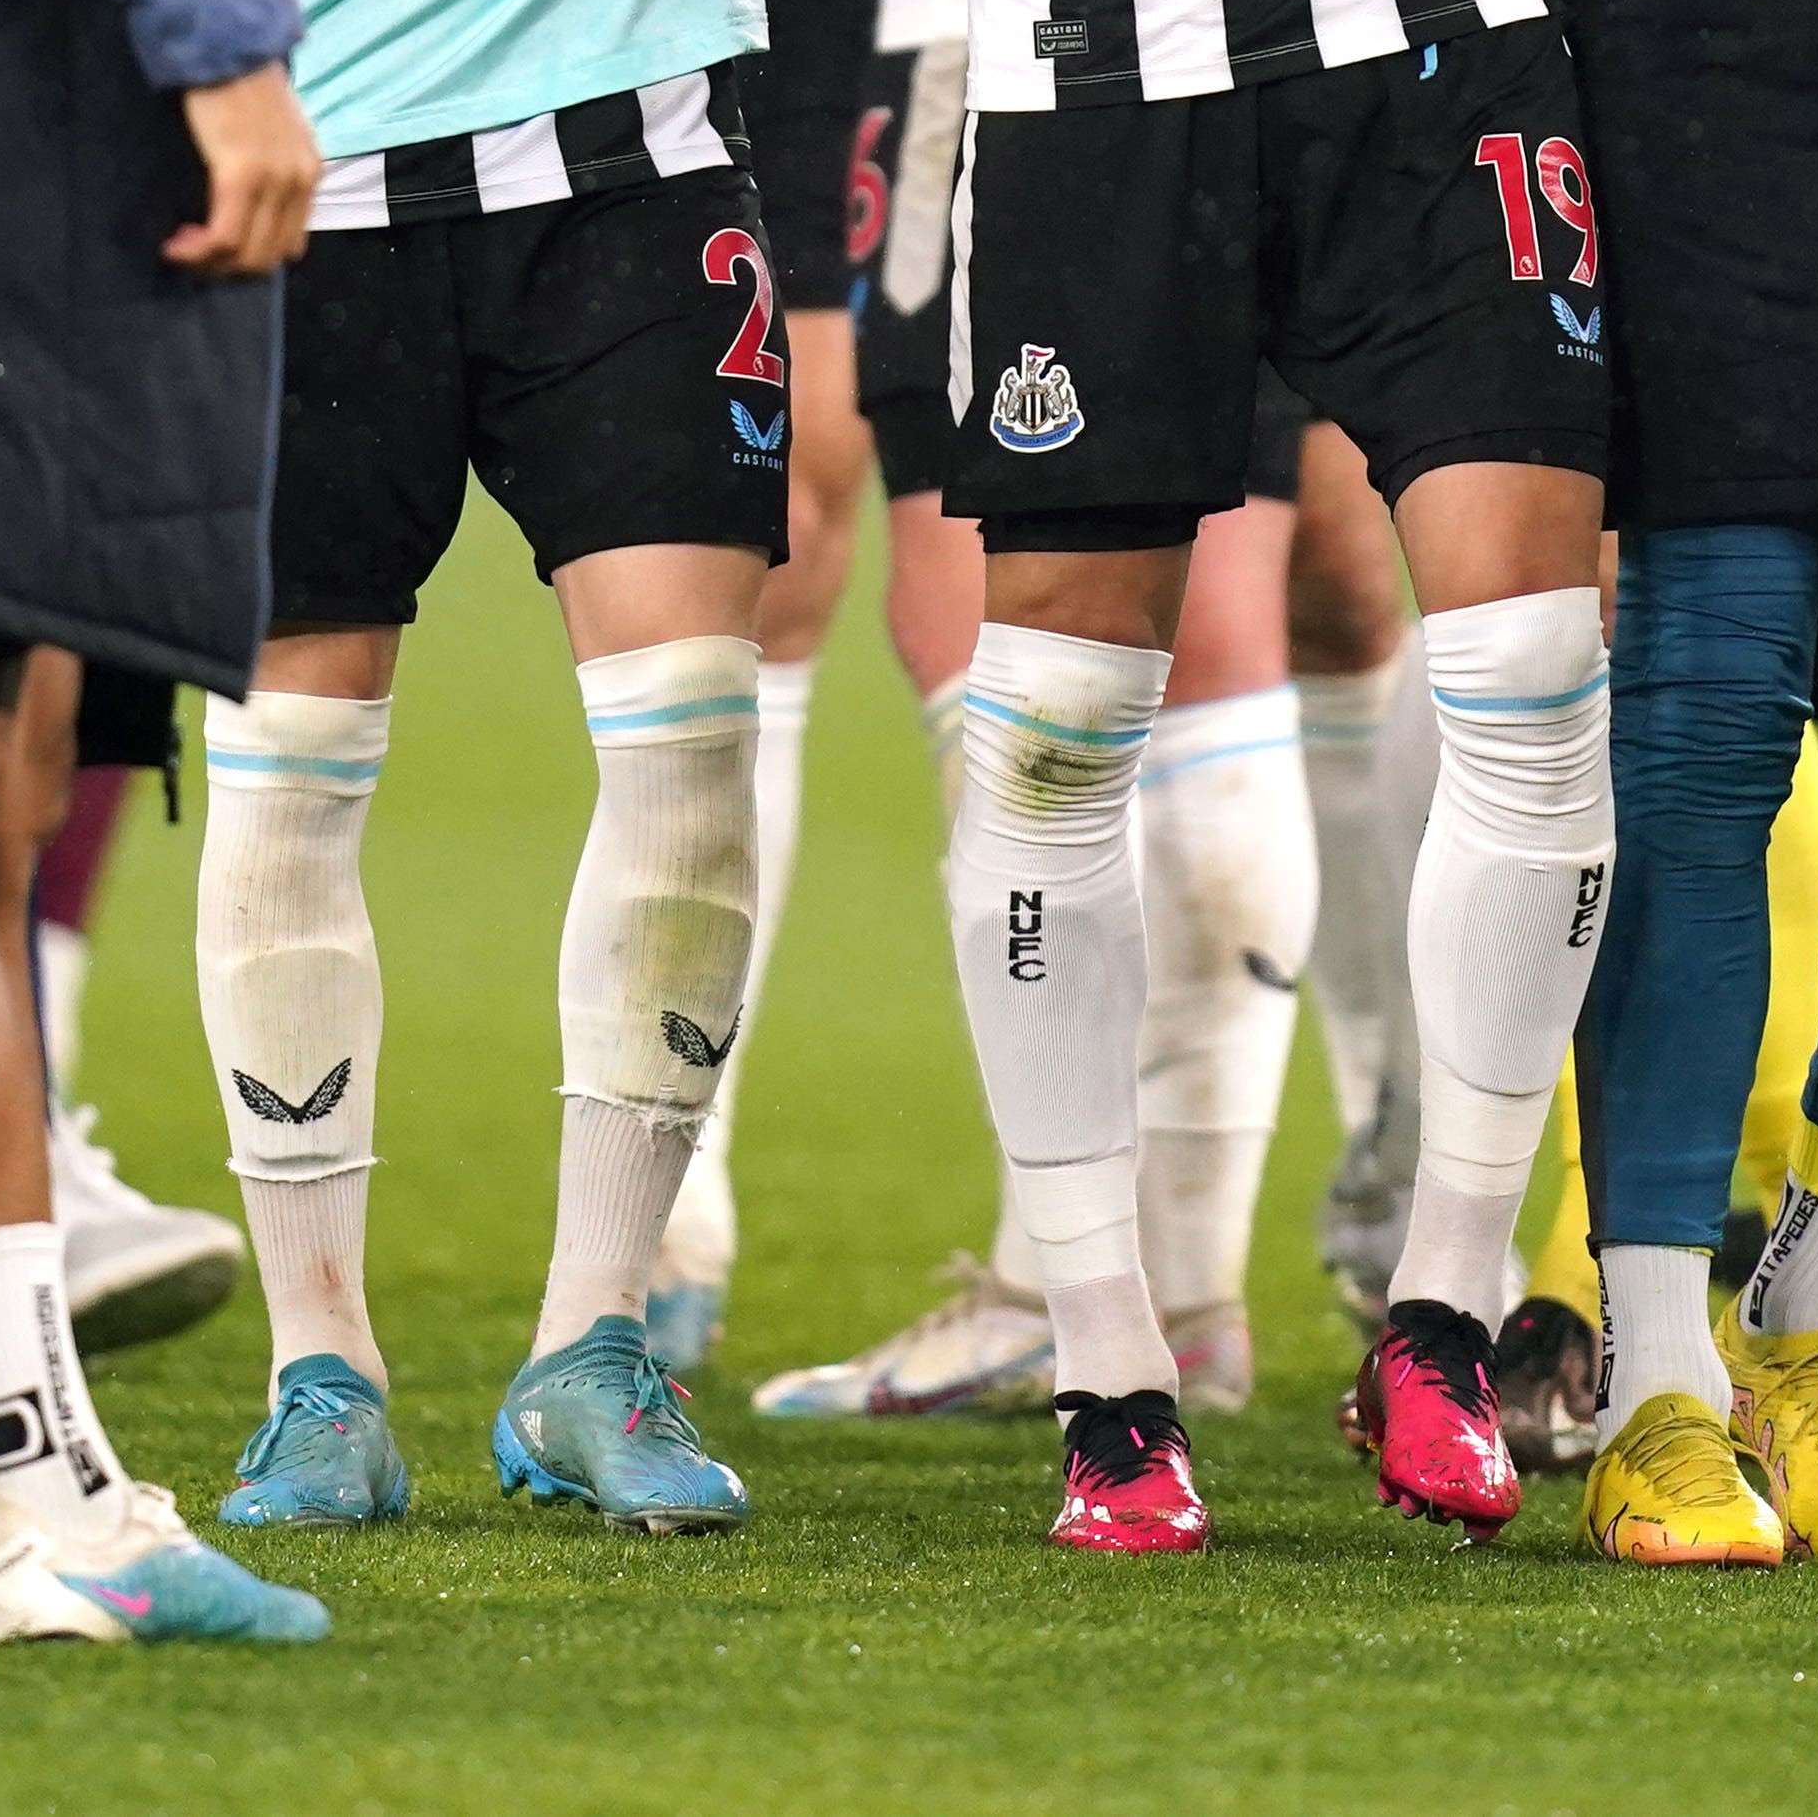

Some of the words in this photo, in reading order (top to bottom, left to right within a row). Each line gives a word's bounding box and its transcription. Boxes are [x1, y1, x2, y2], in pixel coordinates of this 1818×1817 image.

[1474, 132, 1599, 289] 19
[702, 227, 784, 389] 2
[1008, 890, 1046, 982] NUFC
[1567, 862, 1604, 948] NUFC
